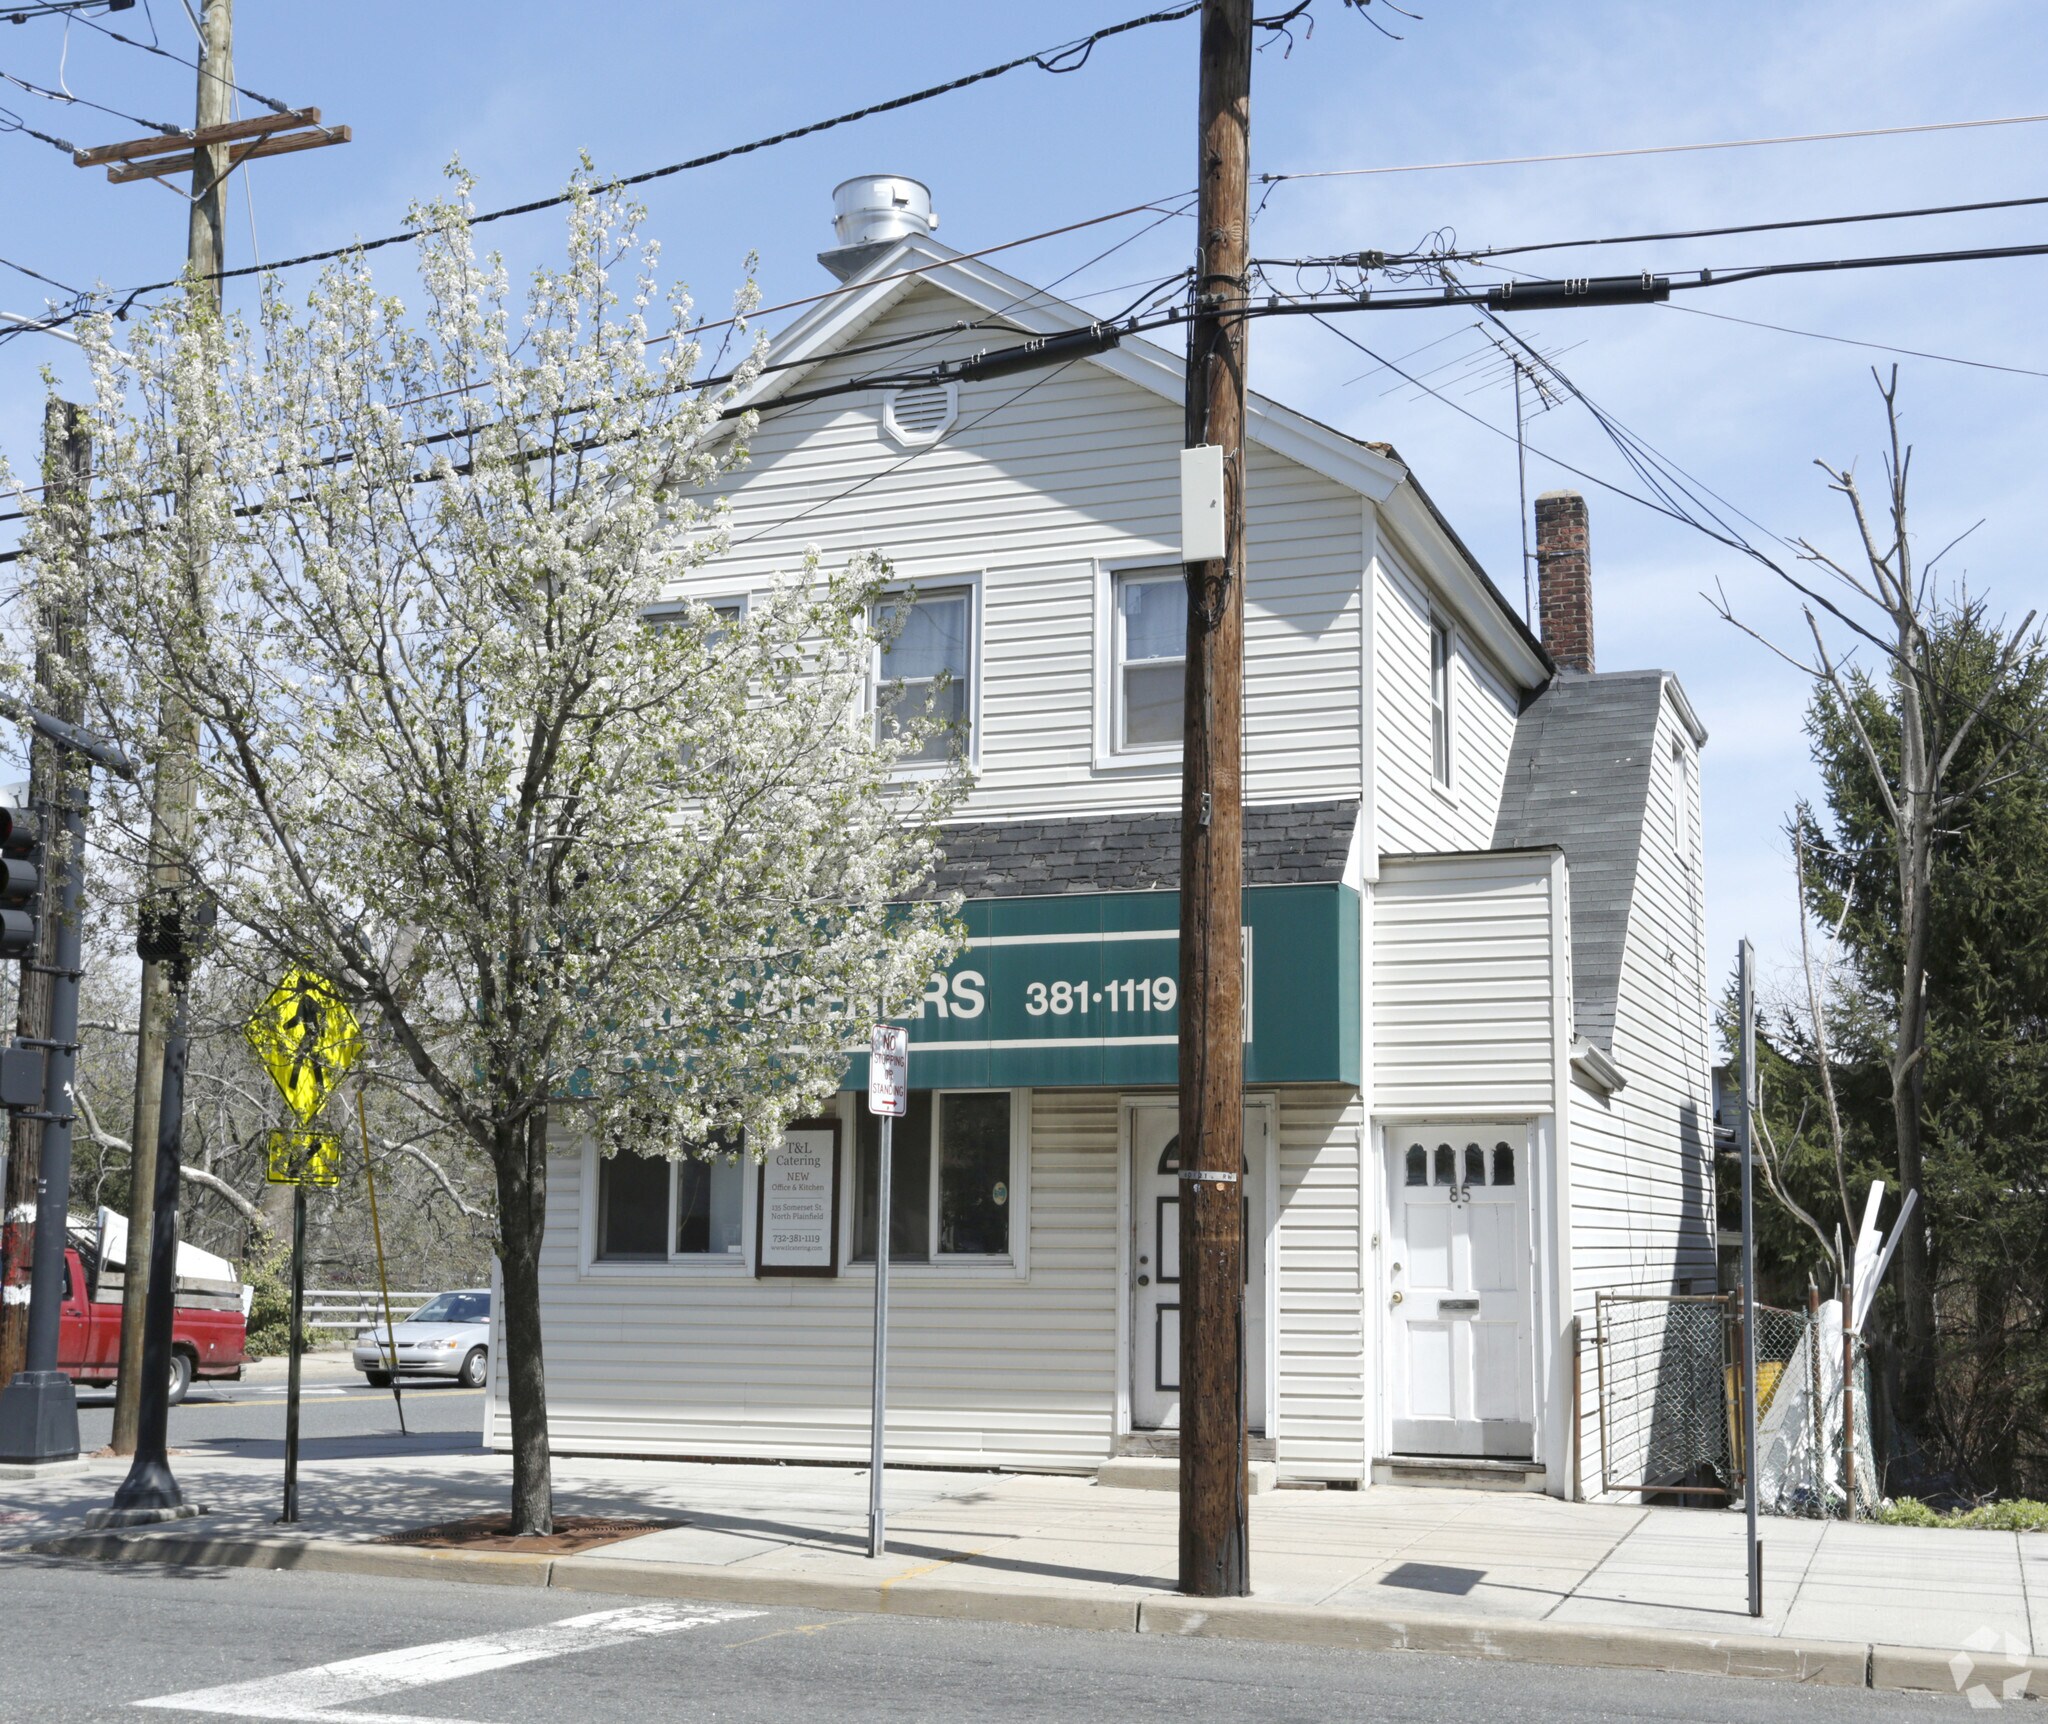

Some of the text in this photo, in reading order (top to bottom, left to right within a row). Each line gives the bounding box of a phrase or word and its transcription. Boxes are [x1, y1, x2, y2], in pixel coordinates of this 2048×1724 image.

[882, 1033, 896, 1051] NO
[873, 1053, 905, 1068] STOPPING
[884, 1069, 894, 1081] OR
[872, 1082, 904, 1097] STANDING
[785, 1141, 813, 1154] T&L
[776, 1154, 821, 1168] Catering
[786, 1172, 810, 1181] NEW
[771, 1183, 825, 1191] Office & Kitchen
[1449, 1186, 1471, 1203] 85
[782, 1203, 814, 1211] Somerset
[814, 1203, 824, 1211] St.
[771, 1212, 824, 1220] North Plainfield
[772, 1233, 820, 1243] 732-381-1119
